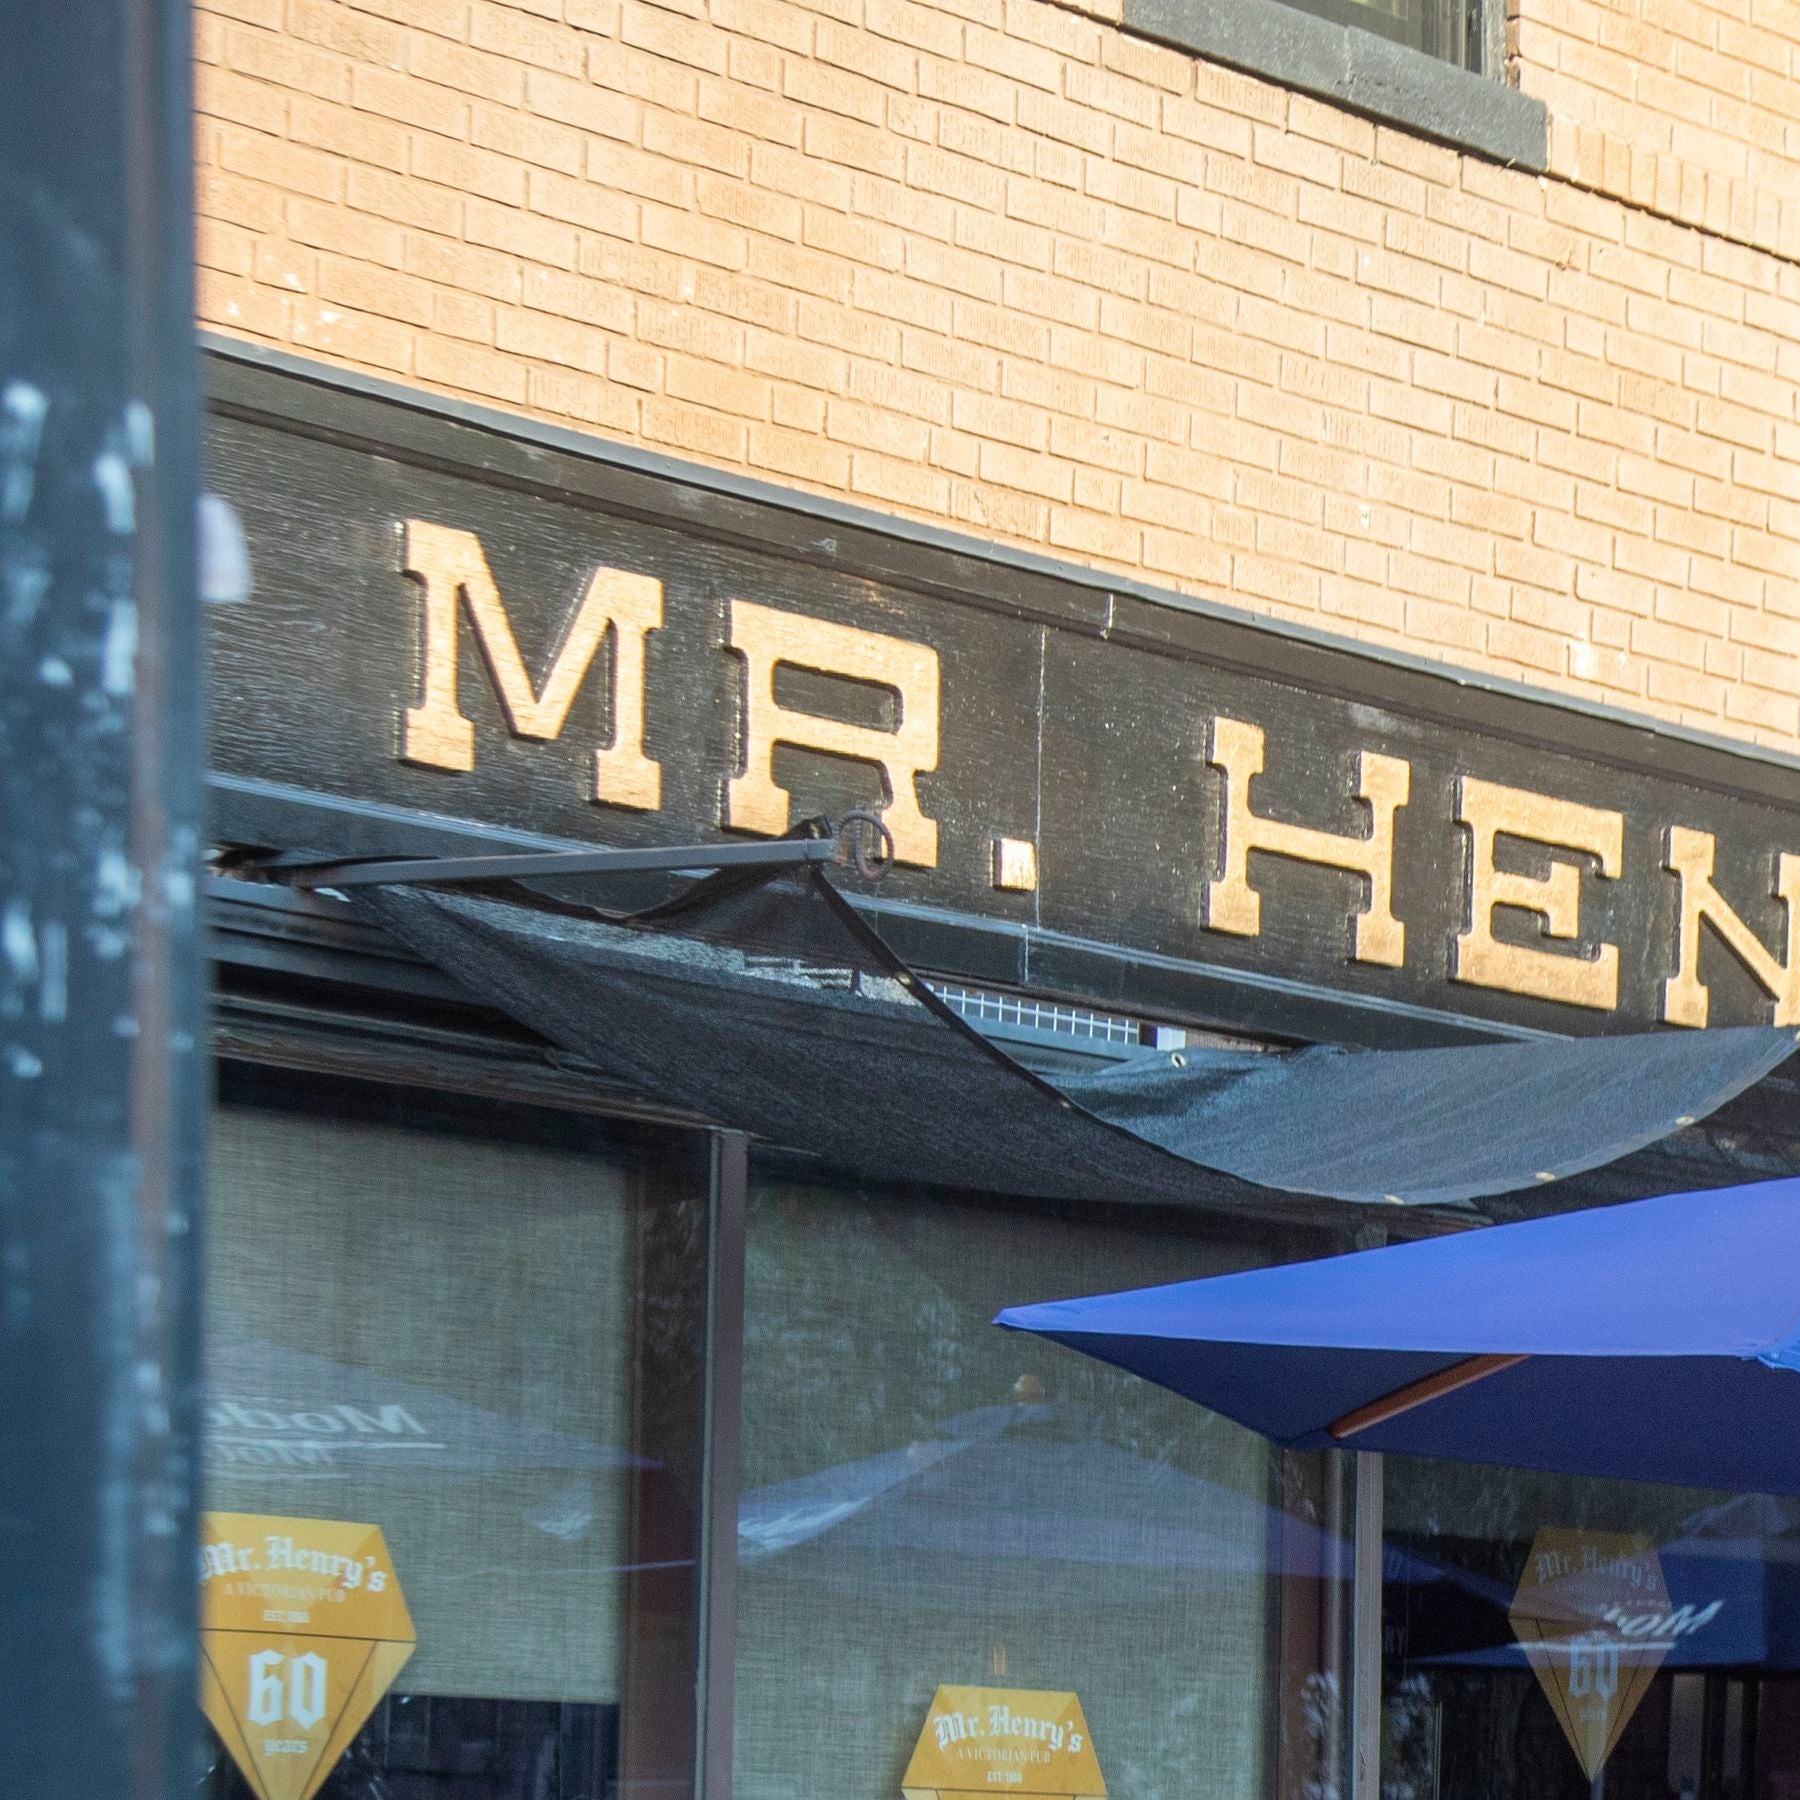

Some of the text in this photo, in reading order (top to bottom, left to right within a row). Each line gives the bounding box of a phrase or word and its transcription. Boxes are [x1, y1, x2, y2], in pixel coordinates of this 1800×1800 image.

[402, 517, 1037, 891] MR.
[194, 1535, 388, 1592] Mr. Henry's
[246, 1649, 328, 1731] 60
[1568, 1635, 1619, 1701] 60
[933, 1703, 1084, 1754] Mr. Henry's
[966, 1748, 1028, 1763] VICTORIAN
[1029, 1750, 1052, 1764] PUB
